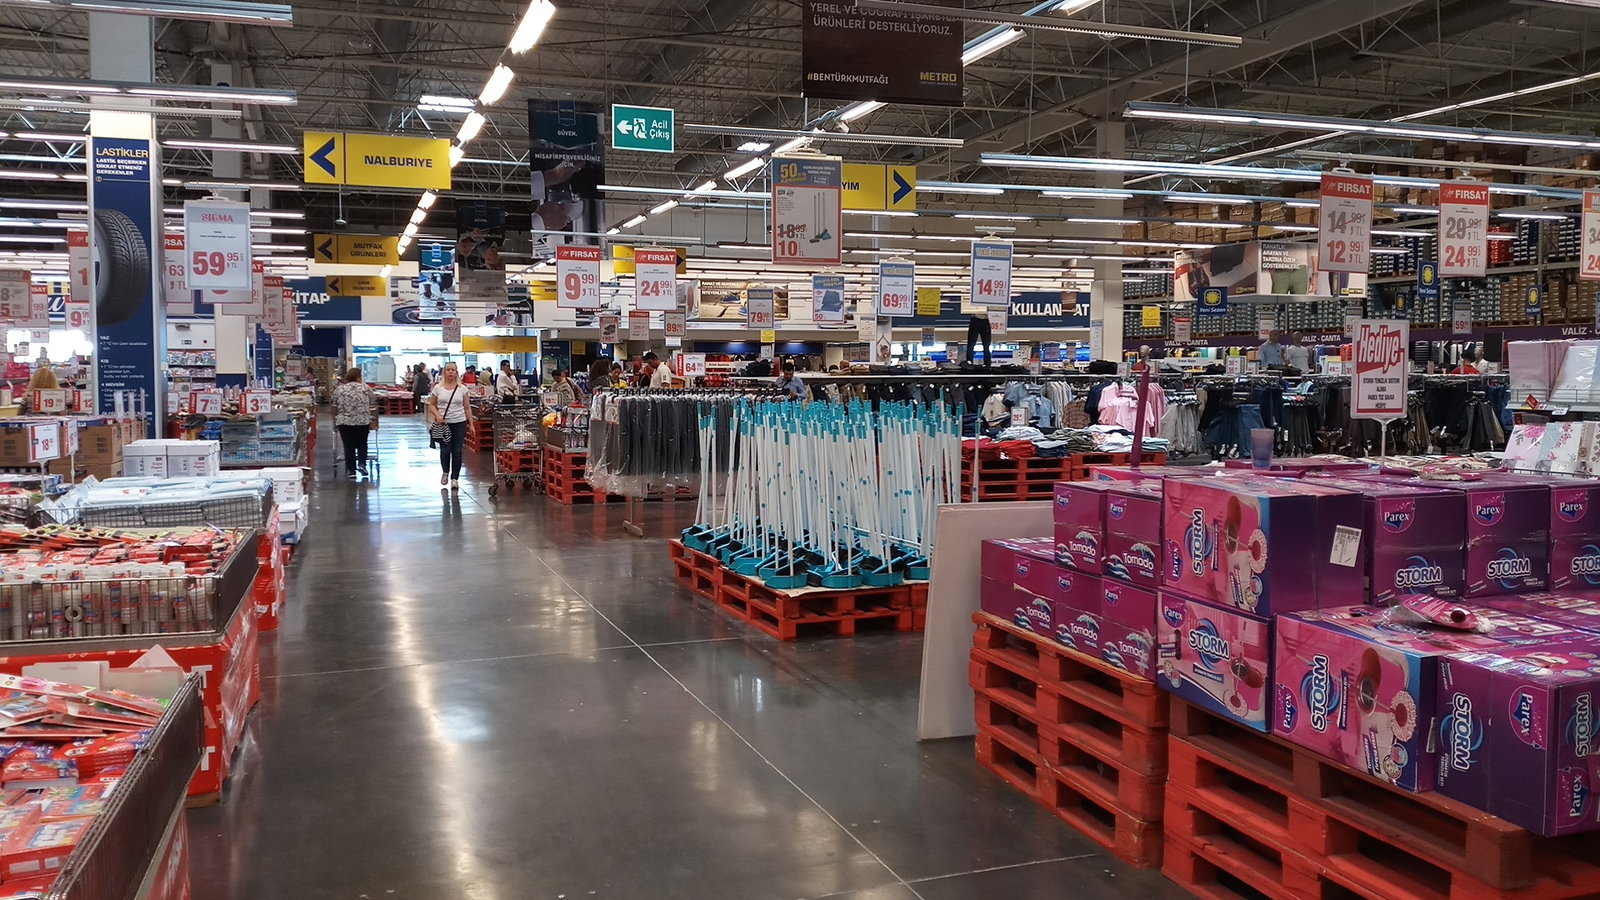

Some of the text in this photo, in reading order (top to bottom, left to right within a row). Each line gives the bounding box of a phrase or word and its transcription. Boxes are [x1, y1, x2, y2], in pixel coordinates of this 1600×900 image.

[810, 2, 856, 15] YEREL VE
[814, 14, 953, 36] ÜRÜNLERİ DESTEKLİYORUZ.
[807, 72, 889, 84] #BENTÜRKMUTFAĞI
[920, 72, 957, 82] METRO
[652, 120, 668, 129] Acil
[650, 128, 670, 140] Çıkış
[96, 146, 149, 158] LASTİKLER
[364, 155, 432, 168] NALBURİYE
[780, 163, 798, 179] 50
[1337, 182, 1372, 194] FIRSAT
[1455, 189, 1486, 200] FIRSAT
[202, 214, 234, 222] SIGMA
[1328, 210, 1346, 234] 14
[1445, 216, 1467, 240] 29
[353, 242, 383, 250] MUTFAK
[570, 250, 598, 258] FIRSAT
[778, 240, 798, 256] 10
[1326, 240, 1362, 264] 12 99 TL
[192, 251, 225, 276] 59
[227, 252, 239, 262] 95
[648, 254, 675, 262] FIRSAT
[1444, 244, 1480, 268] 24 99 TL
[564, 273, 598, 300] 9 99 TL
[640, 280, 660, 296] 24
[660, 280, 669, 288] 99
[977, 279, 992, 295] 14
[994, 280, 1004, 288] 99
[883, 293, 898, 308] 69
[1012, 302, 1090, 316] KULLAN AT
[70, 310, 82, 328] 9
[750, 312, 762, 323] 79
[666, 323, 676, 332] 89
[1562, 327, 1587, 336] VALİZ
[1359, 327, 1399, 371] Hediye
[686, 363, 696, 372] 64
[44, 399, 54, 408] 19
[201, 399, 209, 412] 7
[250, 399, 259, 412] 3
[1476, 505, 1500, 515] Parex
[1560, 502, 1584, 512] Parex
[1384, 511, 1410, 522] Parex
[1069, 541, 1096, 556] Tomado
[1192, 508, 1204, 577] STORM
[1123, 553, 1154, 570] Tomado
[1487, 558, 1531, 579] STORM
[1395, 565, 1443, 588] STORM
[1026, 606, 1050, 622] Tomado
[1164, 605, 1183, 621] Parex
[1070, 623, 1098, 640] Tomado
[1118, 641, 1149, 661] Tomado
[1188, 629, 1230, 660] STORM
[1311, 654, 1328, 733] STORM
[1283, 693, 1292, 729] Parex
[1521, 692, 1533, 735] Parex
[1451, 692, 1471, 772] STORM
[1575, 692, 1591, 757] STORM
[1570, 774, 1582, 817] Parex
